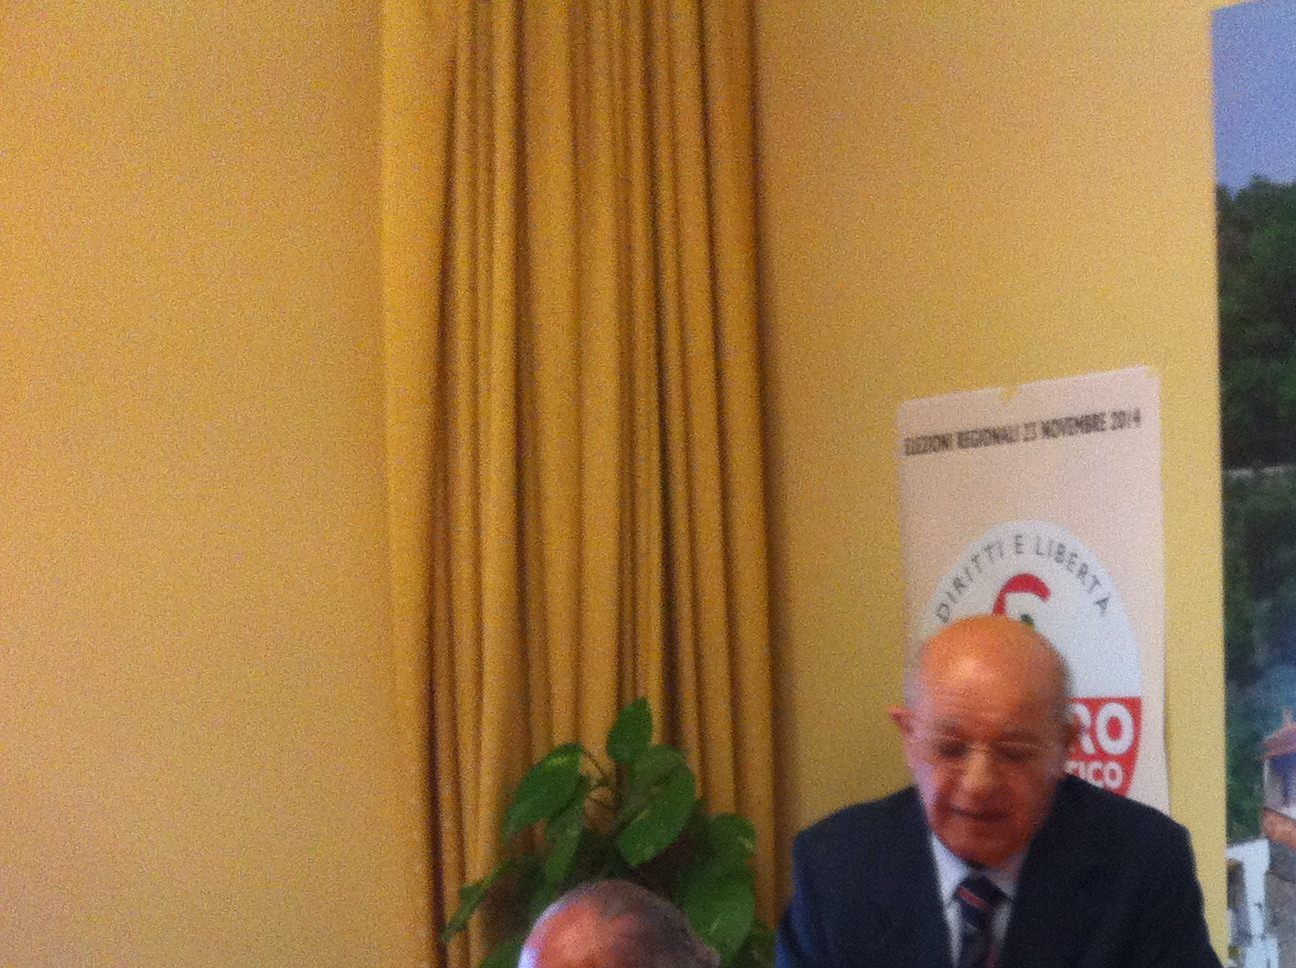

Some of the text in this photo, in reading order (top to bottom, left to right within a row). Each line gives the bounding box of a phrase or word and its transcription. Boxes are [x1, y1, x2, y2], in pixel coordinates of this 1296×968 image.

[1041, 411, 1107, 440] NOVEMBRE
[935, 540, 1005, 624] DIRITTI
[1014, 533, 1025, 556] E
